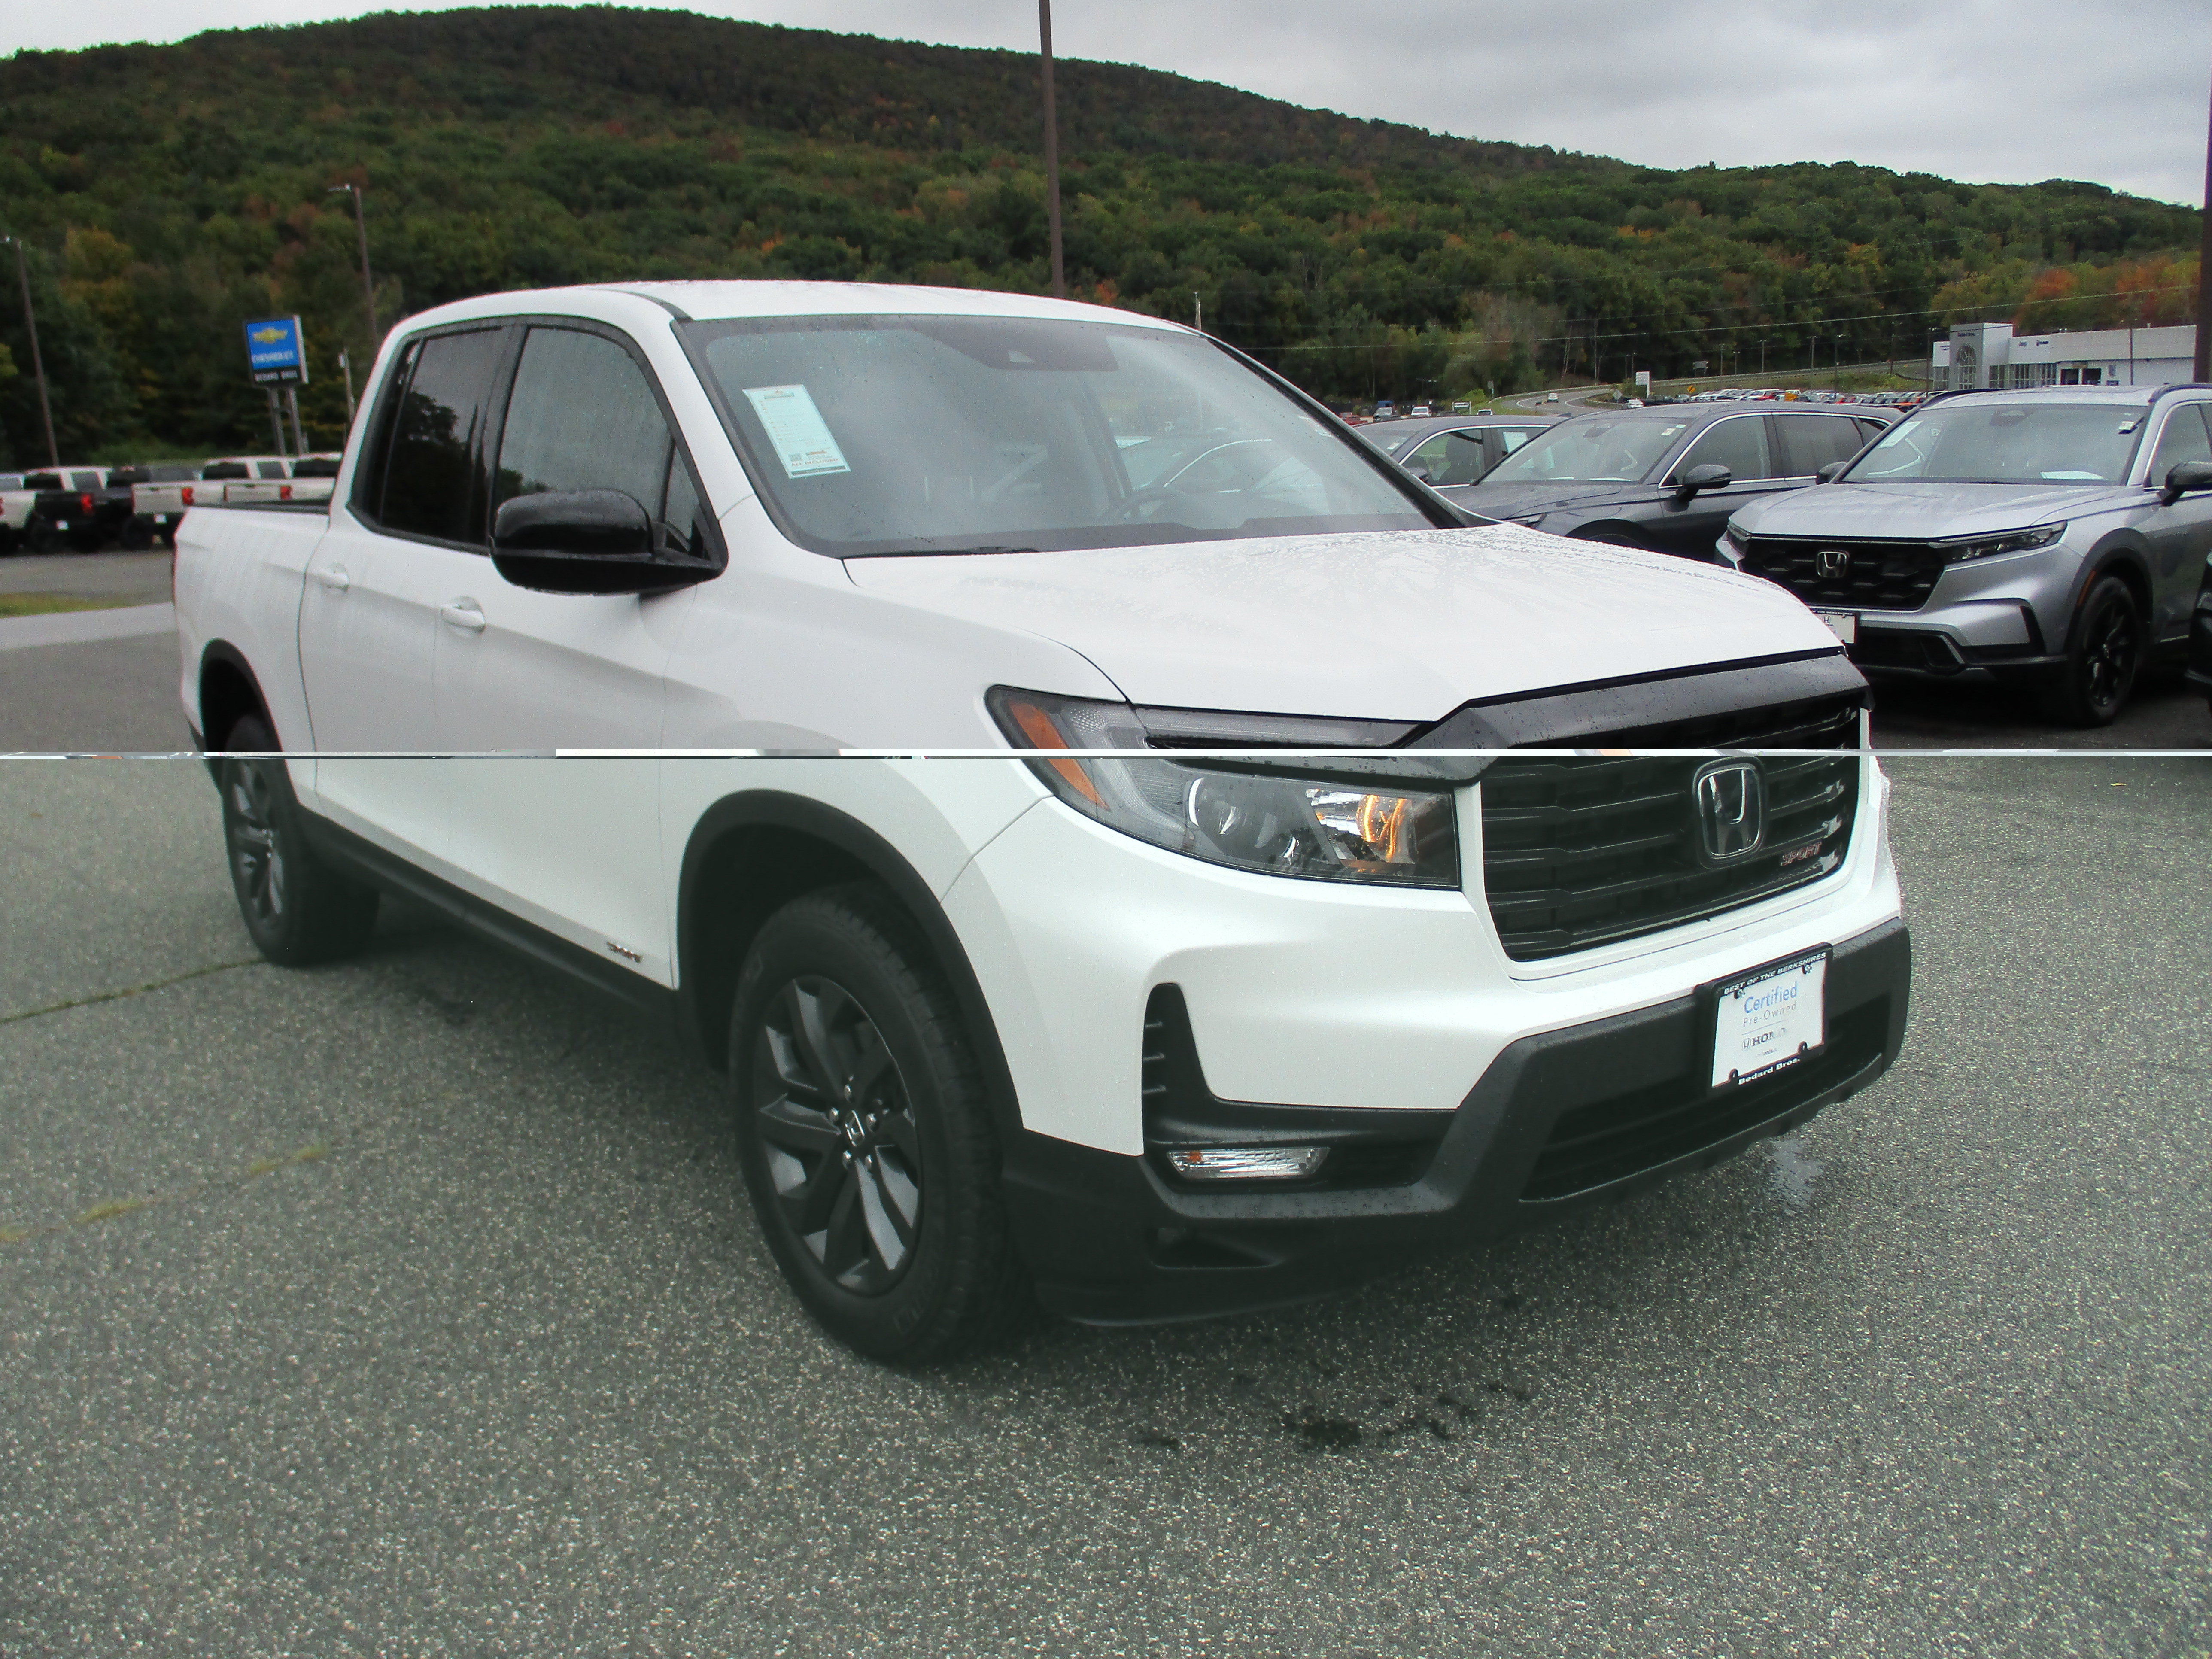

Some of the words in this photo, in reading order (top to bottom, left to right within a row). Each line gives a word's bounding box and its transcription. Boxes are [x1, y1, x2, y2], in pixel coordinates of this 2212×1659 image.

[1781, 842, 1822, 866] SPORT
[1723, 981, 1746, 995] BEST
[1746, 976, 1759, 986] OF
[1760, 970, 1776, 980] THE
[1778, 952, 1827, 975] BERKSHIRES
[1744, 980, 1797, 1014] Certified
[1743, 1001, 1796, 1027] Pre-Owned
[1738, 1066, 1774, 1085] Bedard
[1776, 1058, 1800, 1070] Bros.
